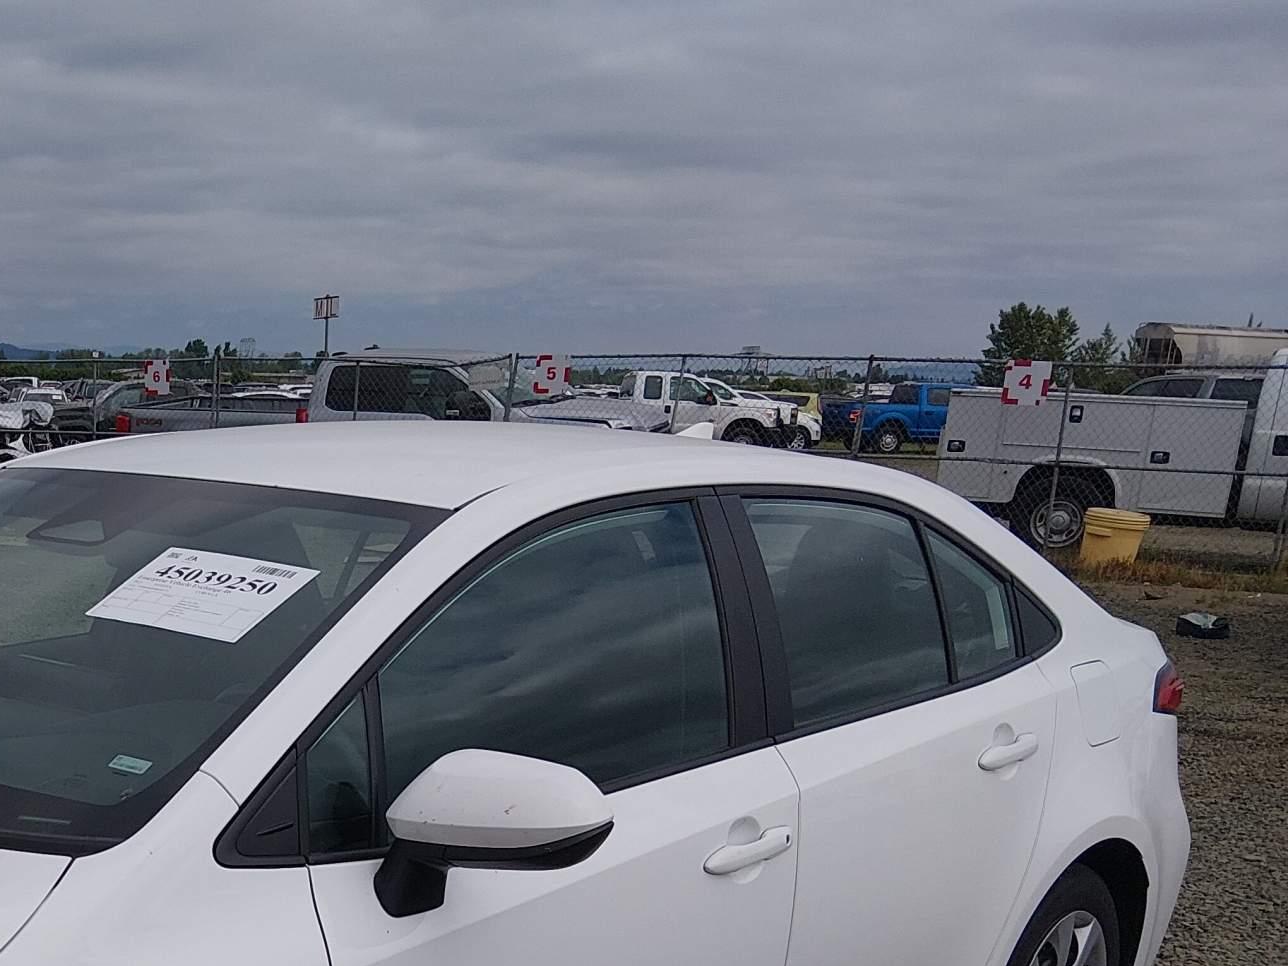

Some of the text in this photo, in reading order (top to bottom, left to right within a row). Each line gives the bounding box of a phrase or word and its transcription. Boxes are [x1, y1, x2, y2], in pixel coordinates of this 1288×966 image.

[152, 370, 161, 383] 6
[546, 367, 557, 381] 5
[1018, 374, 1032, 390] 4
[155, 564, 278, 595] 45039250
